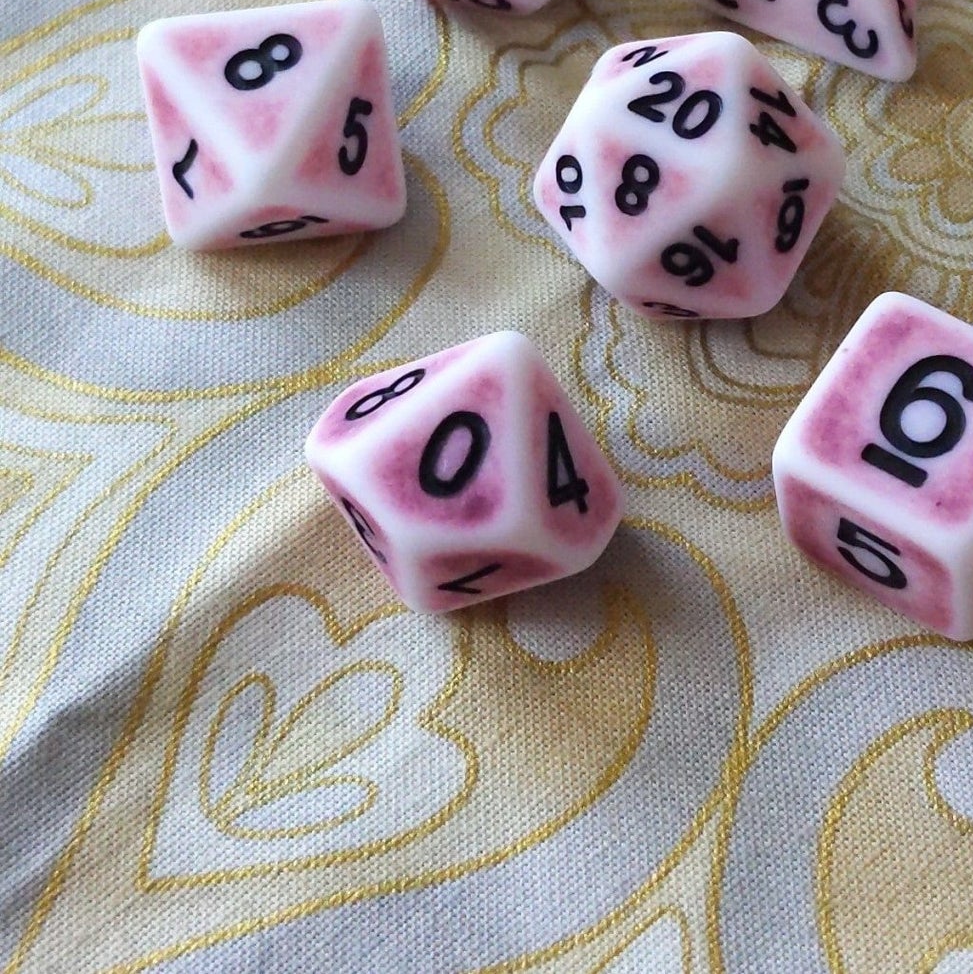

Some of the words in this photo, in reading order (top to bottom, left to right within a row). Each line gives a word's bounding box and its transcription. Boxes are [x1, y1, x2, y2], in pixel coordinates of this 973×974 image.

[224, 32, 304, 91] 8
[338, 96, 373, 176] 5
[626, 70, 724, 140] 20
[749, 87, 798, 153] 14
[614, 153, 661, 216] 8
[344, 368, 427, 421] 8
[418, 410, 493, 499] 0
[547, 410, 591, 514] 4
[836, 517, 908, 590] 5
